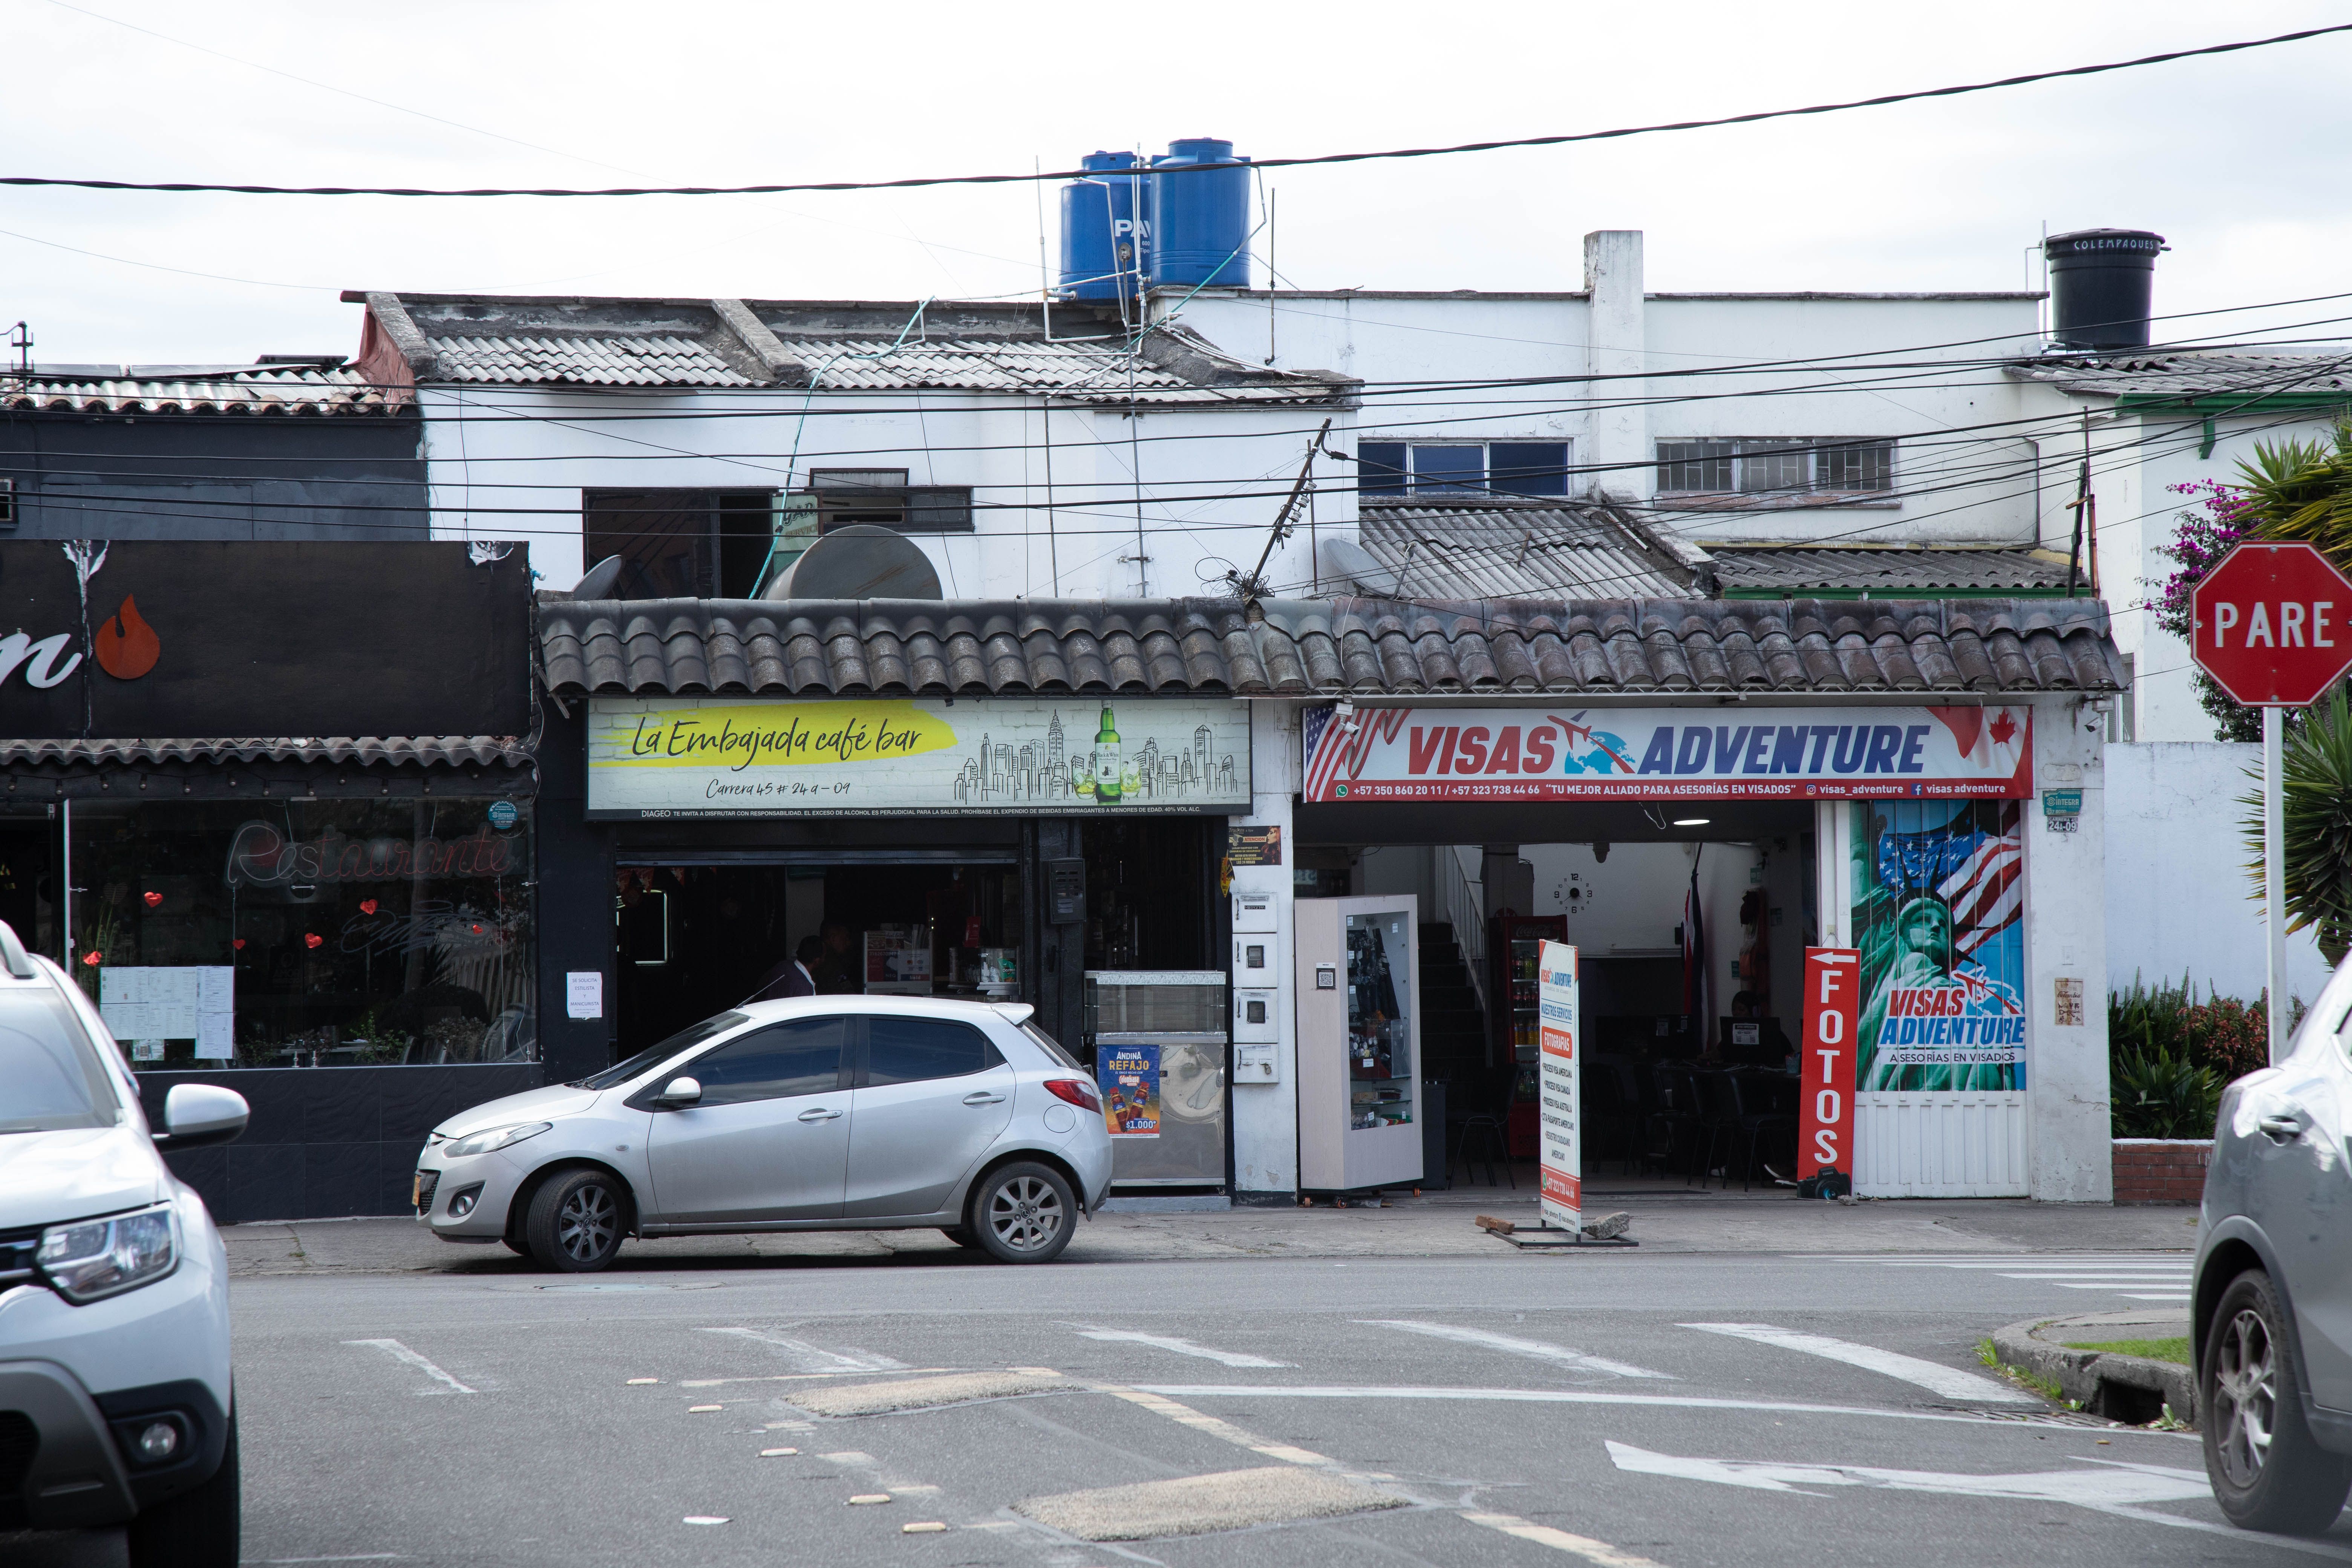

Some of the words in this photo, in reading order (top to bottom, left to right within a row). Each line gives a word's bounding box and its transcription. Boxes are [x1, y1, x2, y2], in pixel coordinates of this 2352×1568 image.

[2074, 239, 2153, 250] COLEMPAQUES
[2215, 602, 2334, 648] PARE
[633, 717, 662, 755] La
[668, 717, 810, 772] Embajada
[815, 718, 871, 761] café
[876, 718, 922, 753] bar
[1409, 726, 1557, 775] VISAS
[1637, 725, 1931, 774] ADVENTURE
[706, 779, 754, 798] Carrera
[756, 782, 773, 796] 45
[776, 785, 789, 795] #
[833, 782, 850, 794] 09
[1354, 786, 1372, 795] +57
[1374, 786, 1392, 795] 350
[1395, 786, 1413, 795] 860
[1416, 786, 1427, 795] 20
[1430, 786, 1441, 795] 11
[1452, 786, 1470, 795] +57
[1472, 786, 1490, 795] 323
[1493, 785, 1511, 794] 738
[1513, 785, 1525, 794] 44
[1528, 785, 1540, 794] 66
[1567, 785, 1601, 794] MEJOR
[1603, 786, 1641, 795] ALIADO
[1643, 786, 1671, 794] PARA
[1673, 782, 1729, 794] ASESORÍAS
[1732, 785, 1745, 793] EN
[1820, 785, 1903, 796] visas_adventure
[1926, 785, 1952, 793] visas
[1954, 784, 2005, 793] adventure
[2049, 821, 2077, 831] 24A-09
[228, 824, 510, 883] Restaurante
[1541, 969, 1550, 983] VISAS
[1554, 971, 1572, 988] ADVENTURE
[1889, 989, 1965, 1017] VISAS
[1541, 1003, 1556, 1017] NUESTROS
[1557, 1007, 1572, 1021] SERVICIOS
[1880, 1018, 2026, 1046] ADVENTURE
[1544, 1032, 1570, 1052] FOTOGRAFIAS
[1116, 1051, 1142, 1060] ANDINA
[1954, 1053, 1966, 1062] EN
[1970, 1052, 2015, 1062] VISADOS
[1109, 1060, 1149, 1070] REFAJO
[1543, 1063, 1553, 1073] PROCESO
[1559, 1067, 1572, 1079] AMERICANA
[1814, 970, 1843, 1164] FOTOS
[1119, 1075, 1140, 1084] Colombiana
[1545, 1080, 1556, 1091] PROCESO
[1544, 1096, 1554, 1107] PROCESO
[1560, 1101, 1572, 1113] AUSTRALIA
[1548, 1114, 1561, 1127] PASAPORTE
[1561, 1119, 1574, 1131] AMERICANO
[1546, 1131, 1557, 1142] REGISTRO
[1557, 1135, 1570, 1147] CIUDADANO
[1551, 1149, 1565, 1161] AMERICANO
[1565, 1184, 1570, 1197] 44
[1570, 1186, 1575, 1199] 66
